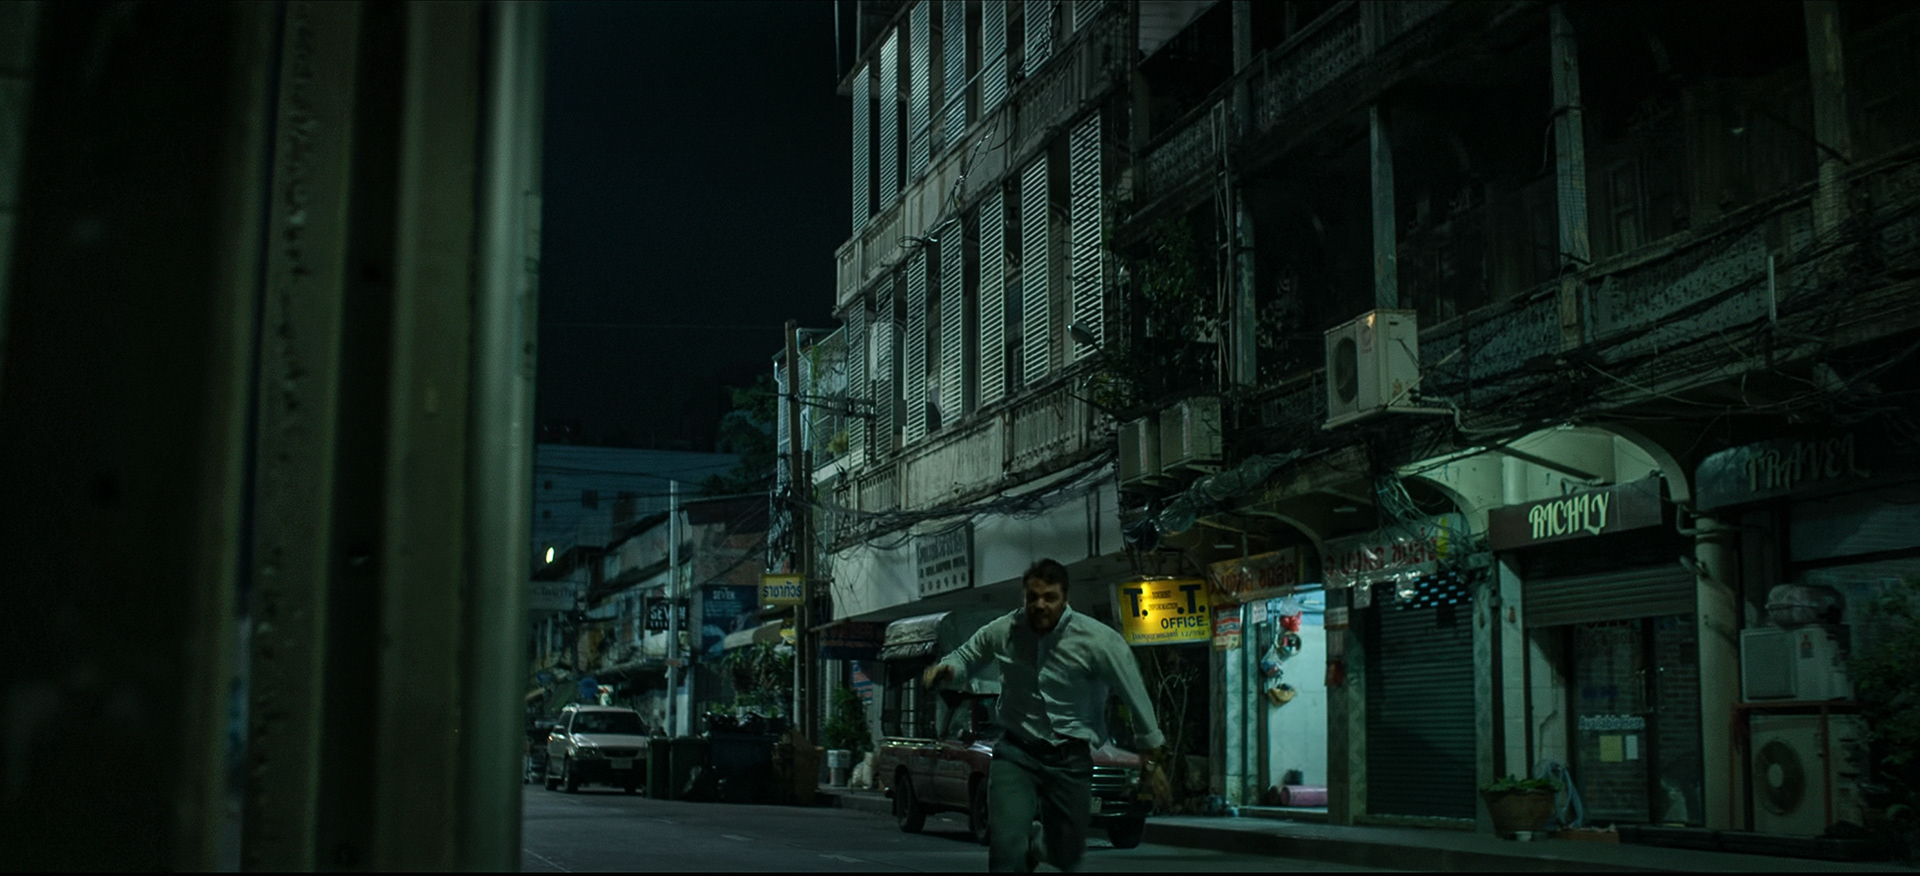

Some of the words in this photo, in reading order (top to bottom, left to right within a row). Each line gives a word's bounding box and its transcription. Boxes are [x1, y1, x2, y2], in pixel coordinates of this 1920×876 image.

[1745, 432, 1872, 493] TRAVEL
[1528, 491, 1610, 539] RICHLY
[712, 588, 735, 600] SEVEN
[649, 605, 687, 621] SEVN
